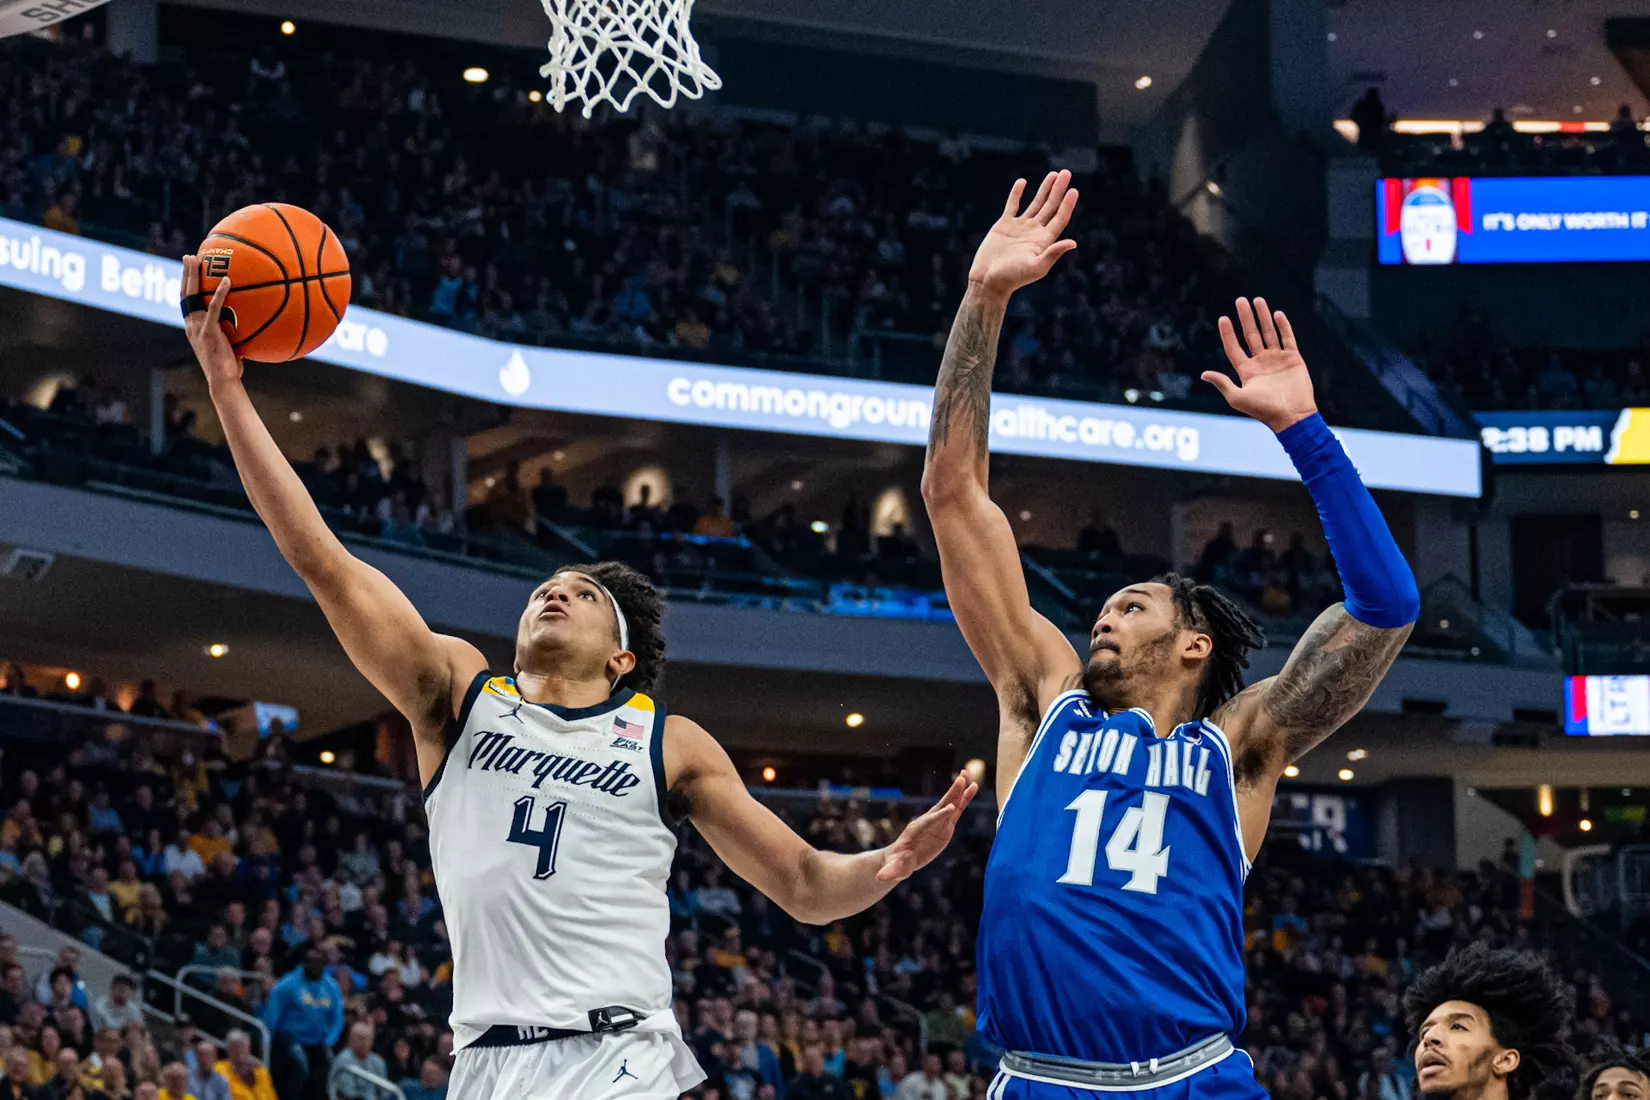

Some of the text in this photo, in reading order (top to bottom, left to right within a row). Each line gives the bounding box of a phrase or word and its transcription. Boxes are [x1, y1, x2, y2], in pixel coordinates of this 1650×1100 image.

[20, 0, 100, 22] SH
[1482, 211, 1516, 231] IT'S
[1516, 212, 1562, 231] ONLY
[1563, 211, 1630, 230] WORTH
[100, 252, 181, 308] Bette
[1553, 425, 1604, 452] PM
[467, 730, 641, 798] Marquette
[1053, 727, 1212, 797] SETON HALL
[506, 795, 568, 880] 4
[1055, 788, 1171, 896] 14
